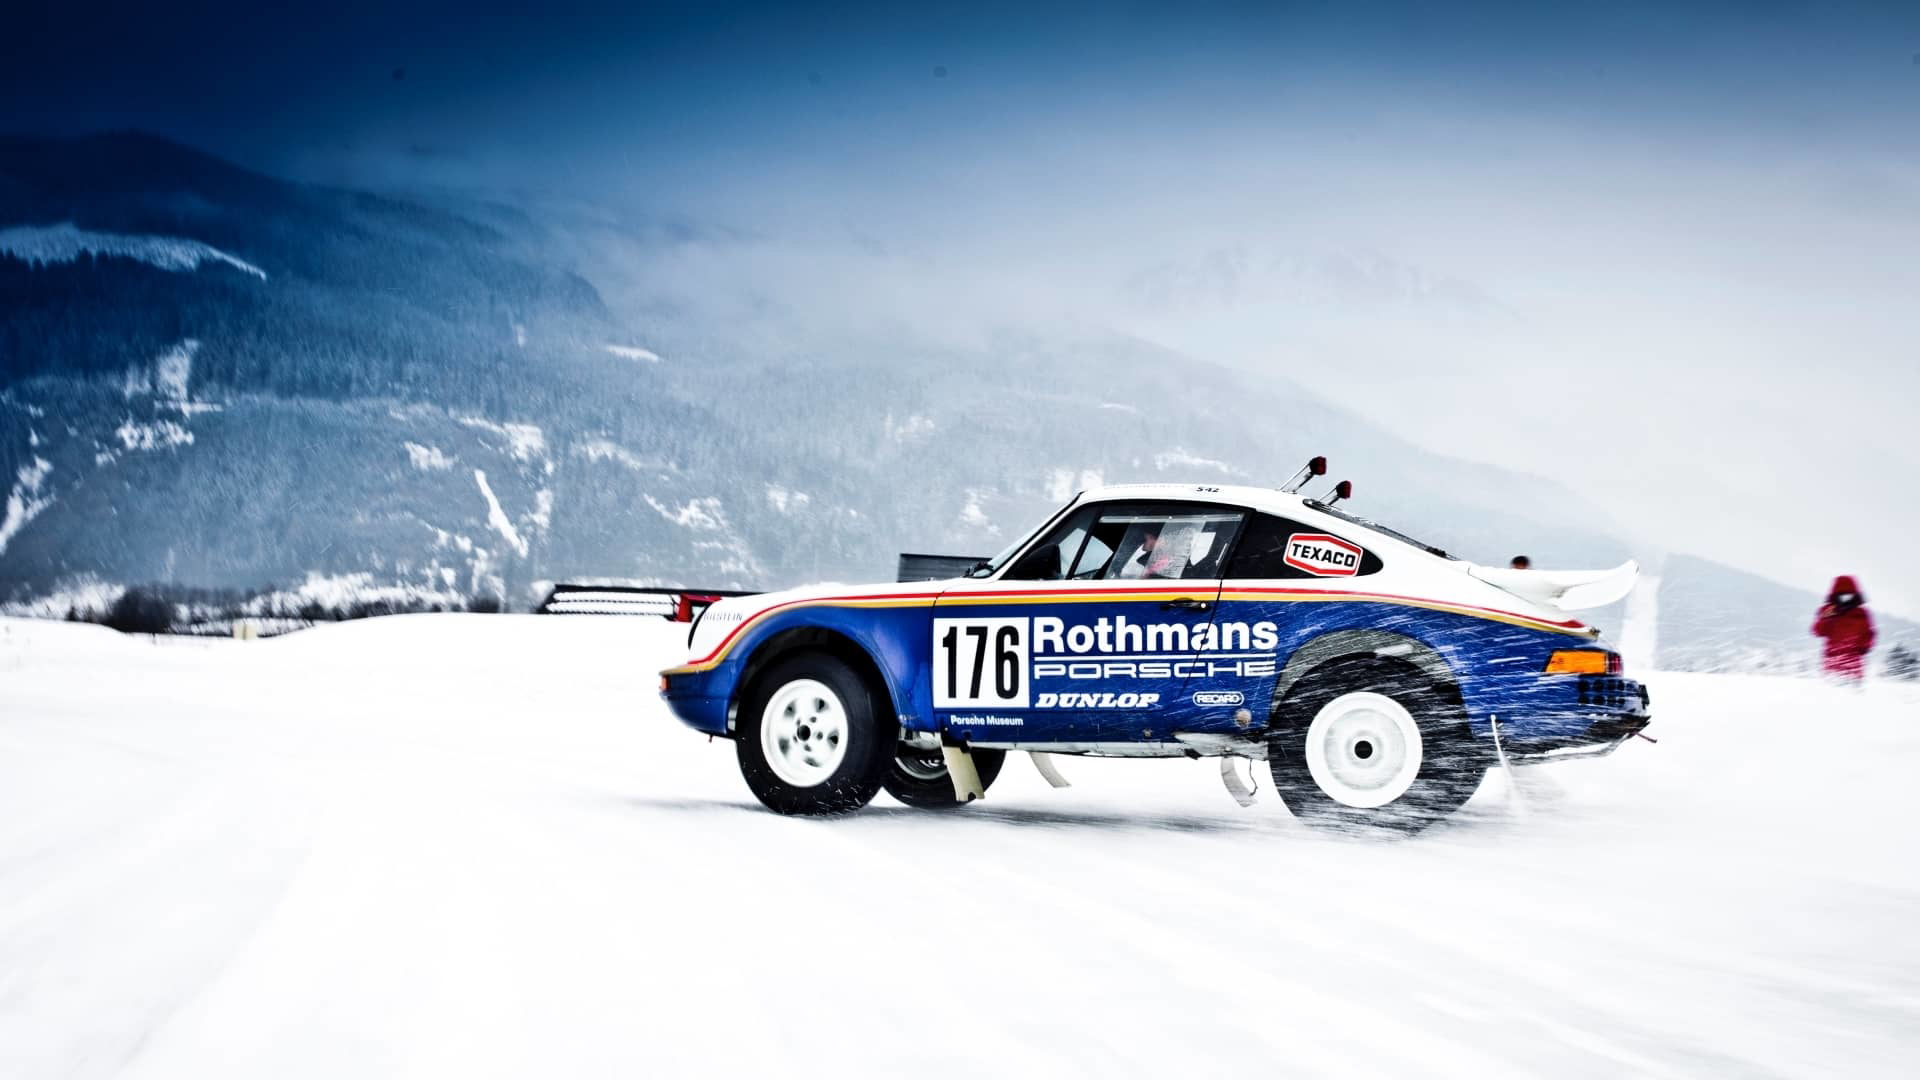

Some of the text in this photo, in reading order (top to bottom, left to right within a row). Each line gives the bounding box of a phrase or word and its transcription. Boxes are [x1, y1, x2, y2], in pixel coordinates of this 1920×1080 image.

[1292, 543, 1356, 568] TEXACO
[1033, 615, 1279, 654] Rothmans
[942, 625, 1020, 700] 176
[1033, 660, 1276, 680] PORSCHE
[1034, 692, 1160, 709] DUNLOP
[1196, 694, 1240, 704] RECARO
[950, 714, 1024, 726] Porsche Museum
